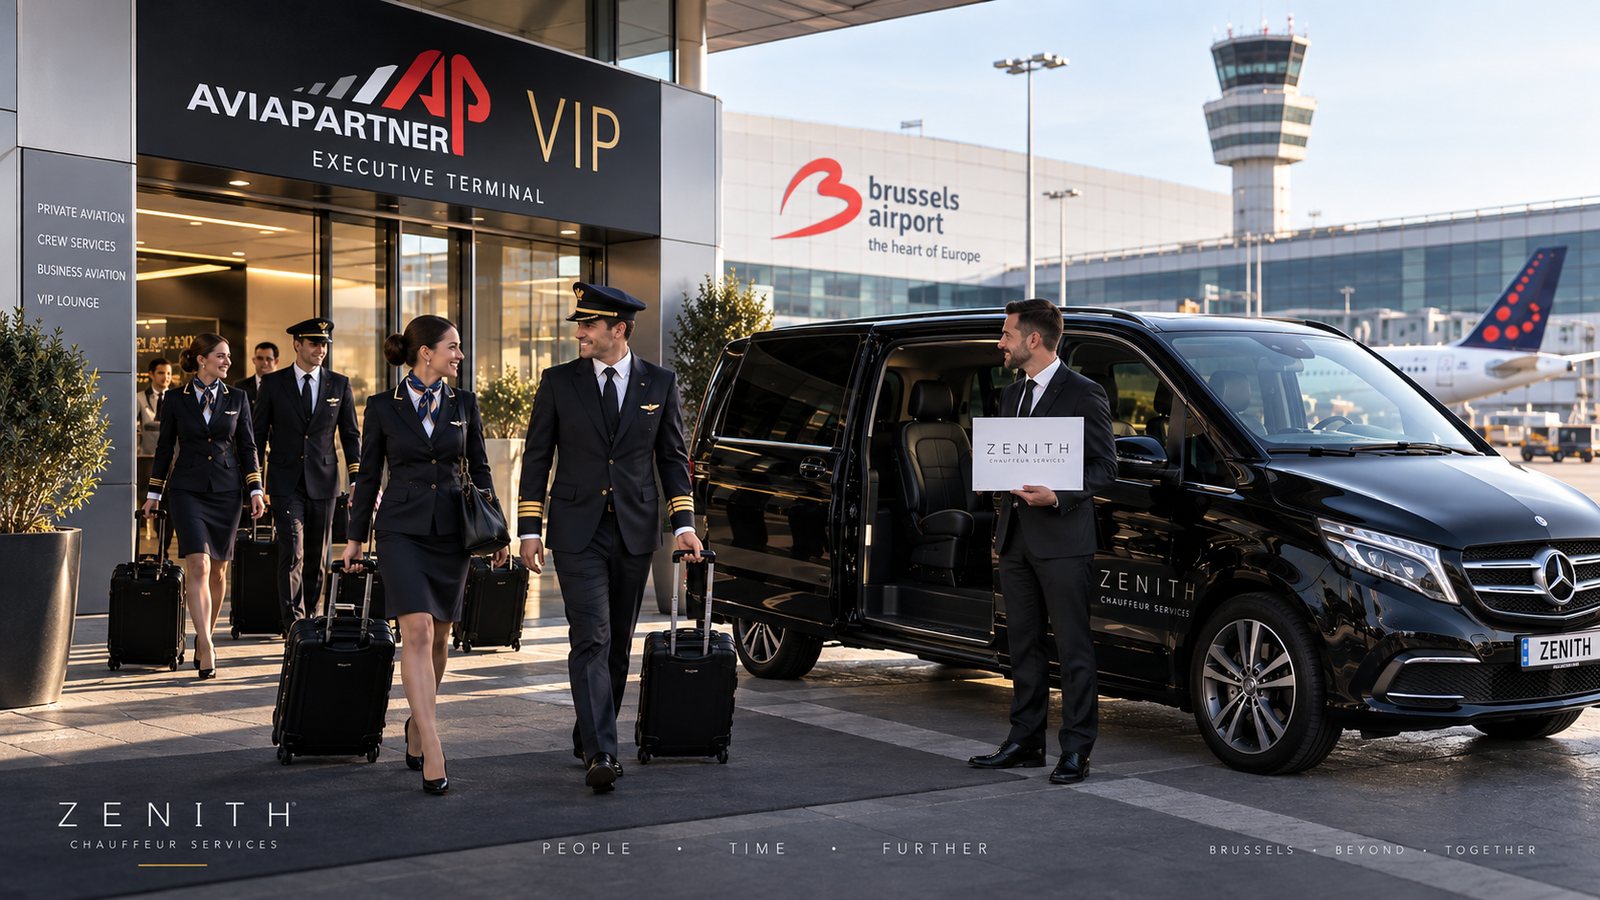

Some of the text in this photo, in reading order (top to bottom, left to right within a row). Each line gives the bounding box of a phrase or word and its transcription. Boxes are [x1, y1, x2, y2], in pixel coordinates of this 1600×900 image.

[187, 83, 450, 155] AVIAPARTNER
[526, 89, 621, 172] VIP
[313, 150, 545, 204] EXECUTIVE TERMINAL
[869, 175, 960, 211] brussels
[37, 203, 125, 224] PRIVATE AVIATION
[868, 204, 944, 236] airport
[37, 234, 116, 252] CREW SERVICES
[868, 237, 981, 265] the heart of Europe
[37, 264, 126, 281] BUSINESS AVIATION
[37, 294, 100, 308] VIP LOUNGE
[987, 443, 1069, 455] ZENITH
[1100, 569, 1195, 601] ZENITH
[1100, 595, 1190, 618] CHAUFFEUR SERVICES
[1540, 637, 1591, 660] ZENITH
